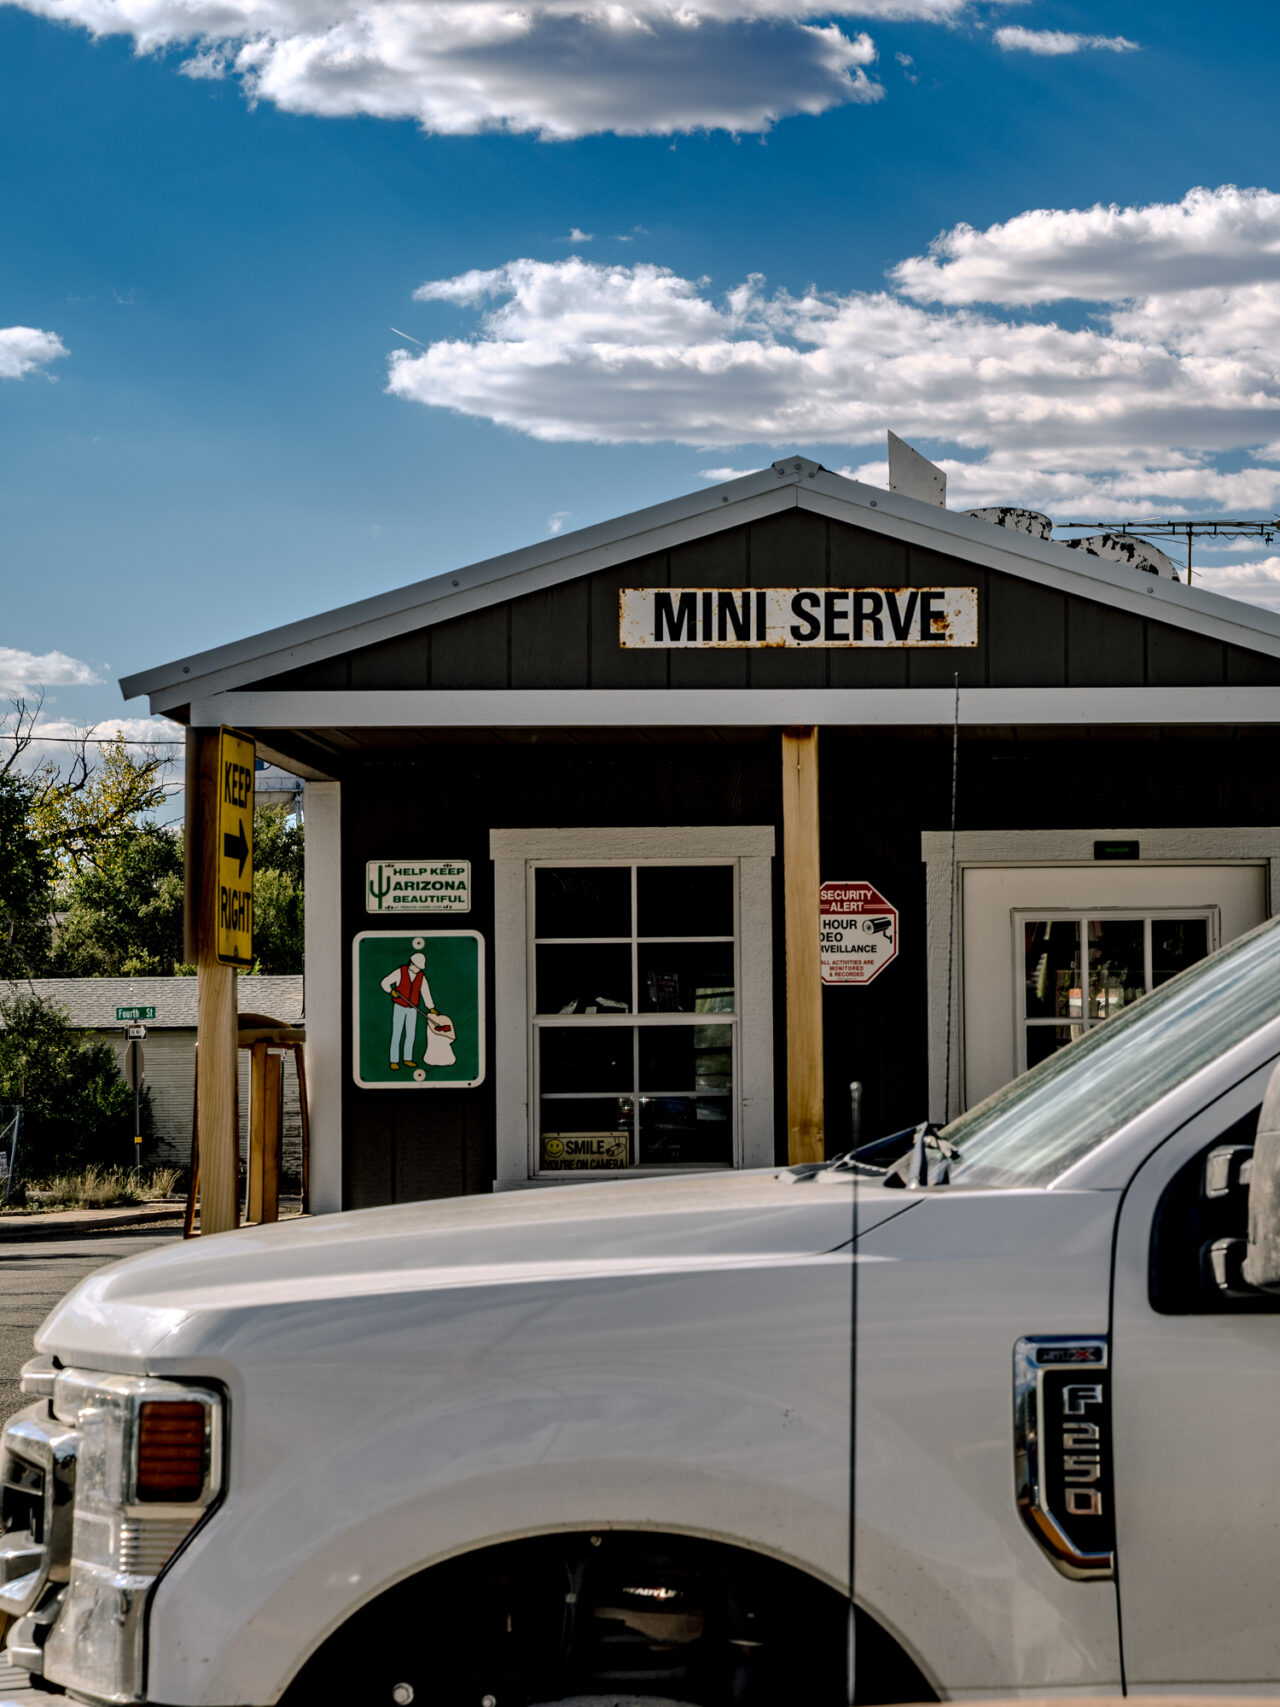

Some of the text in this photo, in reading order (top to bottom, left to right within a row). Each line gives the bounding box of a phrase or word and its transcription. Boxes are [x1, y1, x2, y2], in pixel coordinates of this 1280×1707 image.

[654, 591, 947, 642] MINI SERVE
[224, 760, 250, 809] KEEP
[393, 868, 465, 876] HELP KEEP
[393, 881, 467, 891] ARIZONA
[393, 895, 465, 903] BEAUTIFUL
[820, 890, 873, 900] SECURITY
[221, 886, 250, 934] RIGHT
[830, 902, 864, 912] ALERT
[823, 920, 857, 930] HOUR
[820, 932, 843, 942] DEO
[820, 945, 877, 953] RVEILLANCE
[118, 1008, 153, 1018] Fourth St
[565, 1140, 605, 1155] SMILE
[576, 1160, 589, 1170] ON
[590, 1160, 626, 1170] CAMERA
